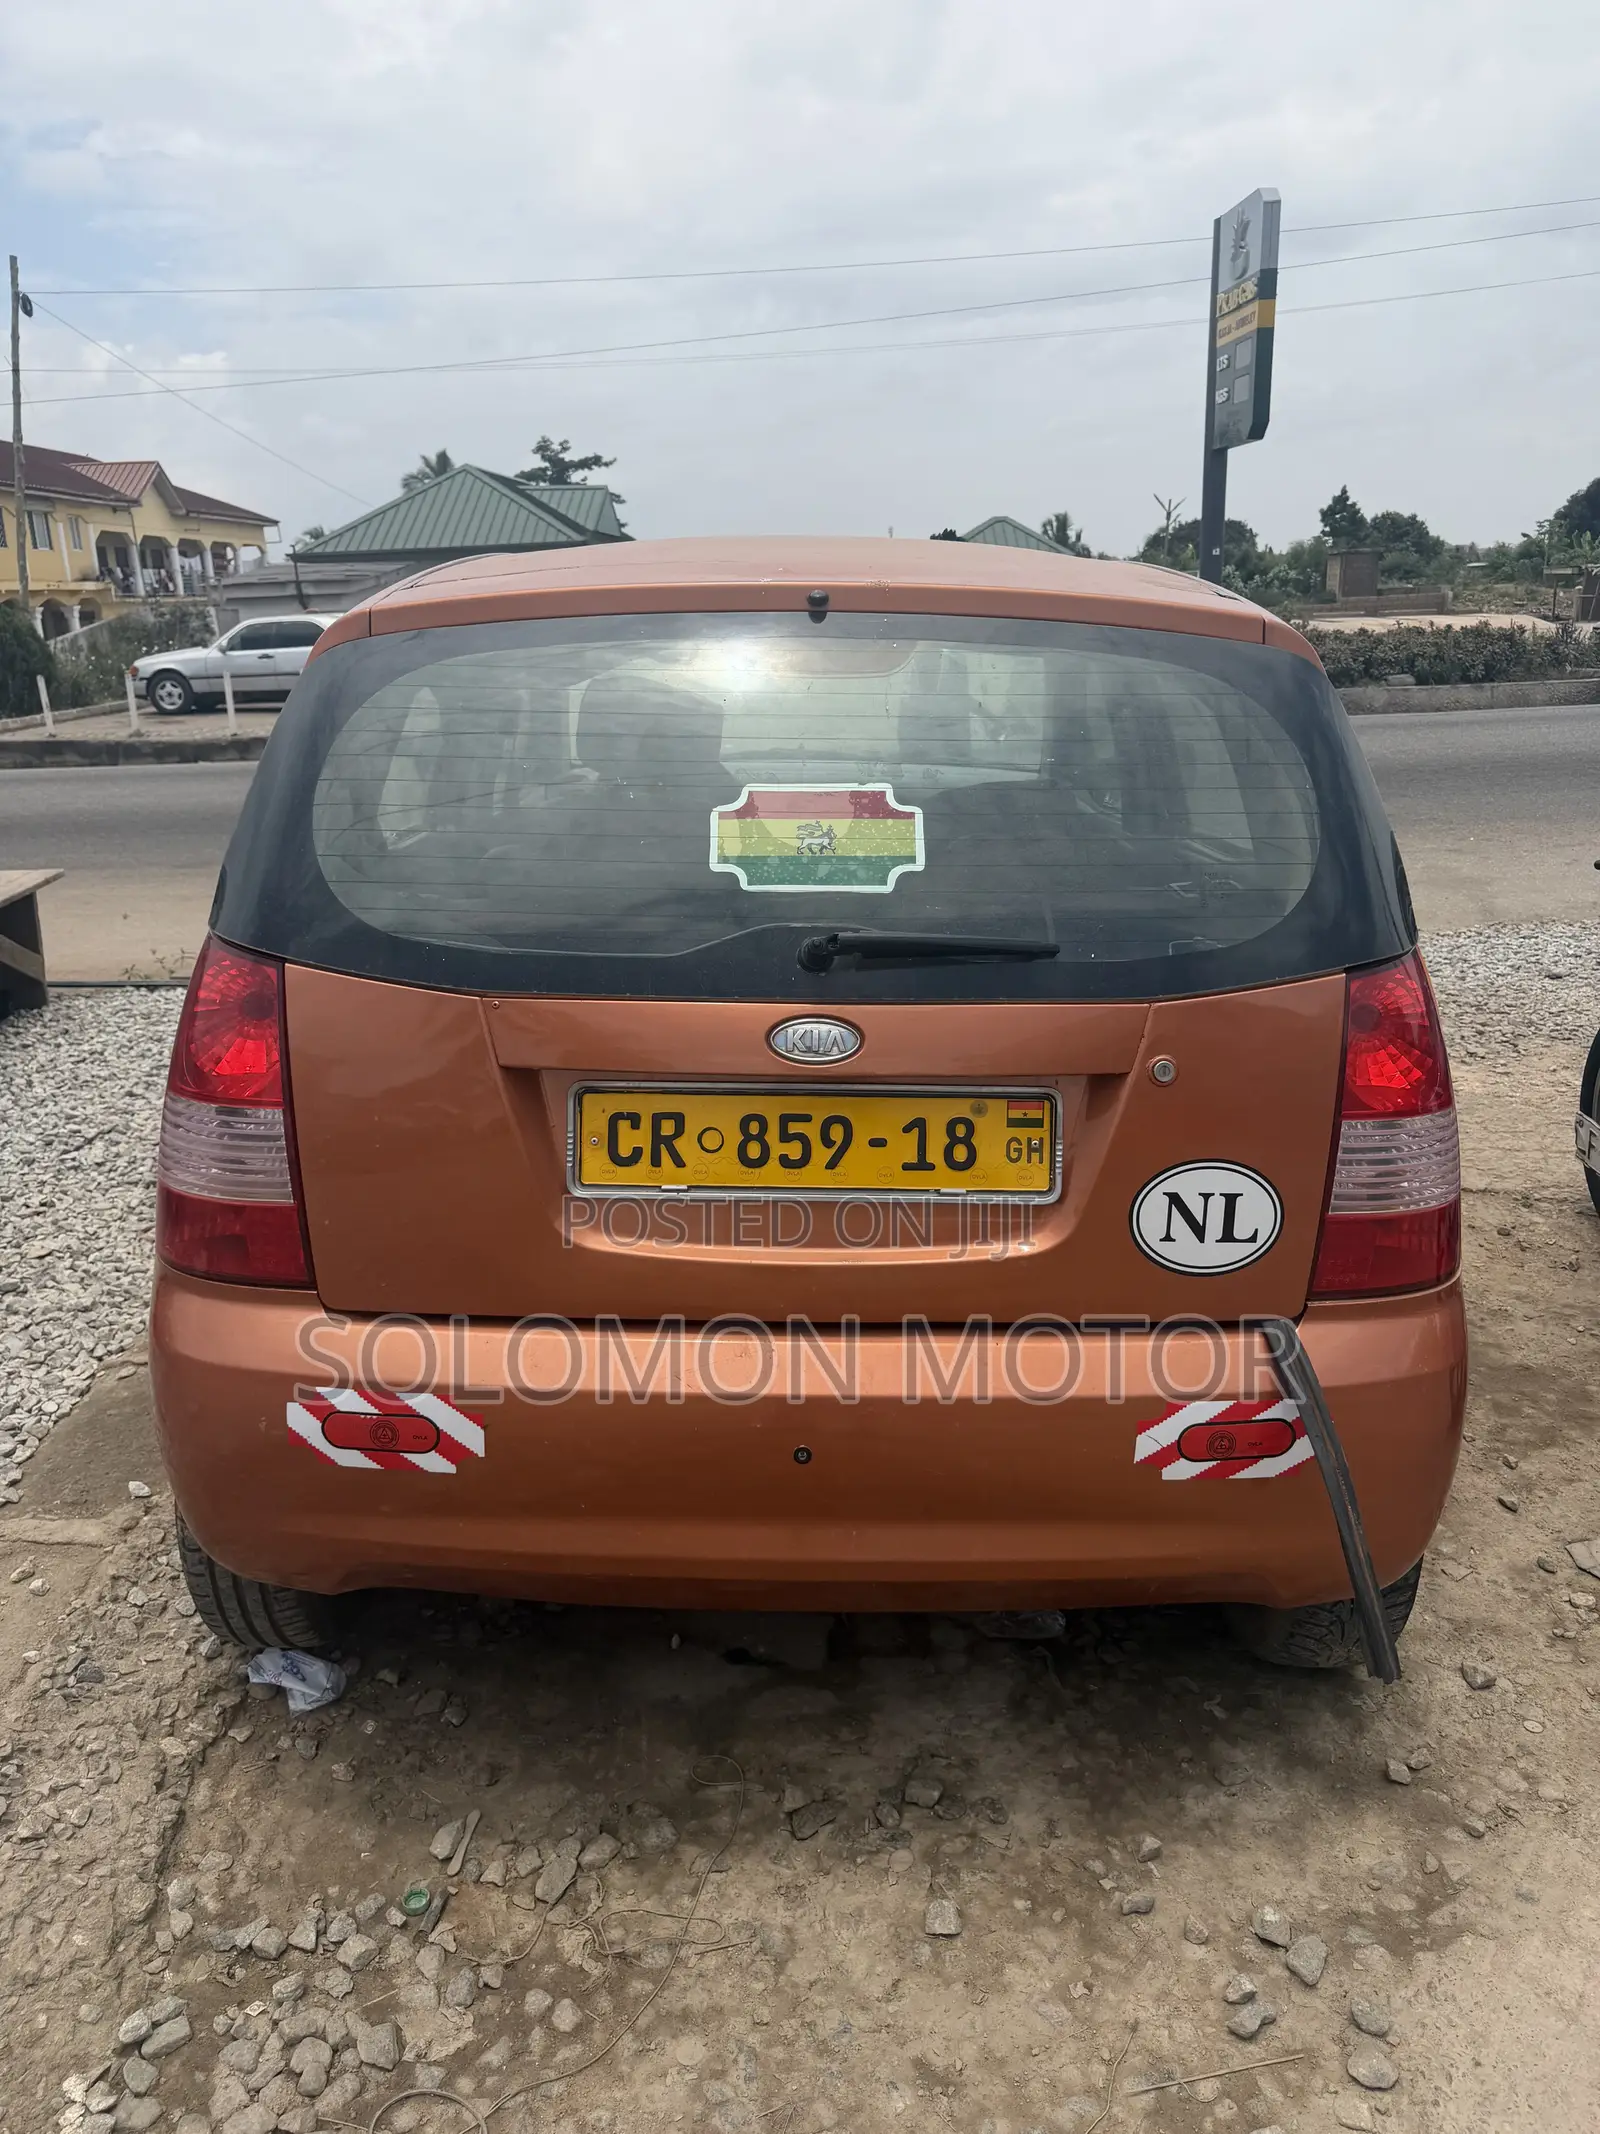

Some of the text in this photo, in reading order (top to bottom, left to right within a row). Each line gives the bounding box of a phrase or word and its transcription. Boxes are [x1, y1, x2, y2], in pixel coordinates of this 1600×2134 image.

[785, 1028, 847, 1053] KIA
[607, 1111, 686, 1168] CR
[1005, 1136, 1045, 1165] GH
[1158, 1191, 1260, 1245] NL
